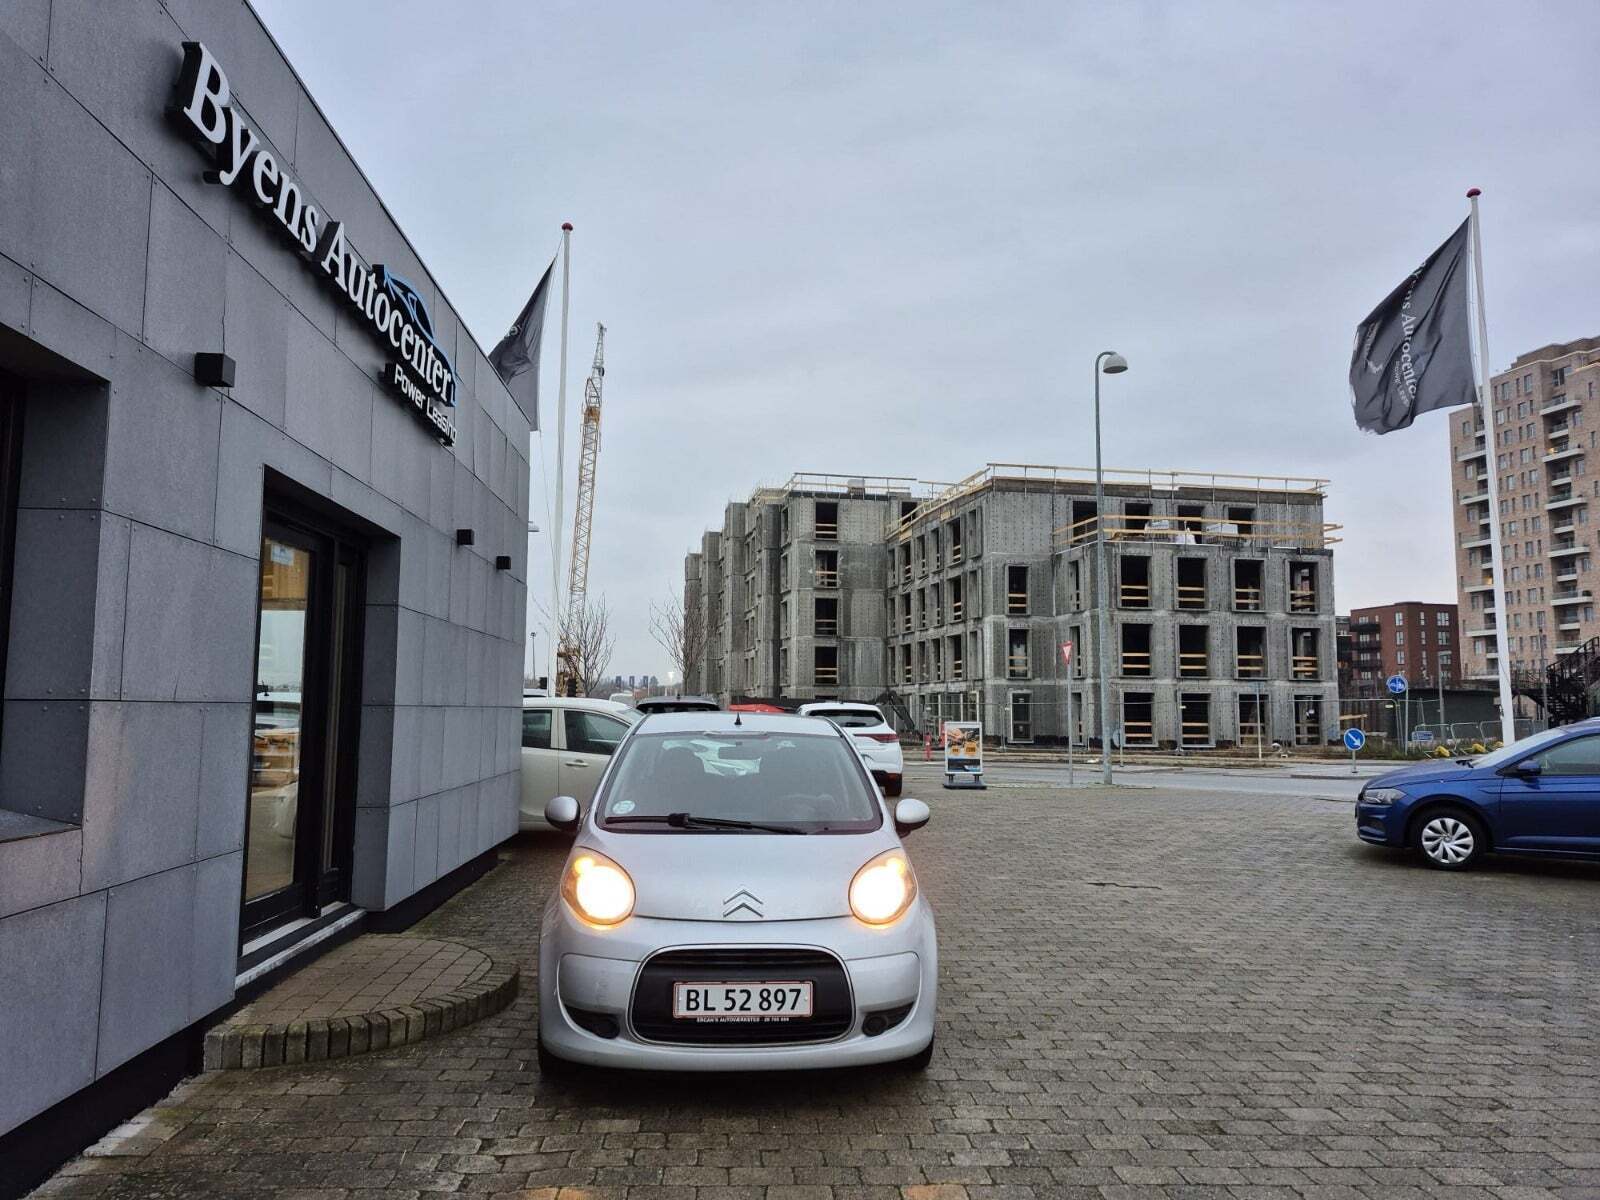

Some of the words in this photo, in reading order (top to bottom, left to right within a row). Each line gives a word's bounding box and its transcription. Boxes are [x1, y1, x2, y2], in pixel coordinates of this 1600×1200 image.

[183, 42, 320, 253] Byens
[321, 221, 452, 402] Autocenter
[394, 363, 427, 409] Power
[426, 396, 458, 447] Leasing
[686, 989, 716, 1012] BL
[724, 988, 752, 1012] 52
[758, 988, 802, 1012] 897
